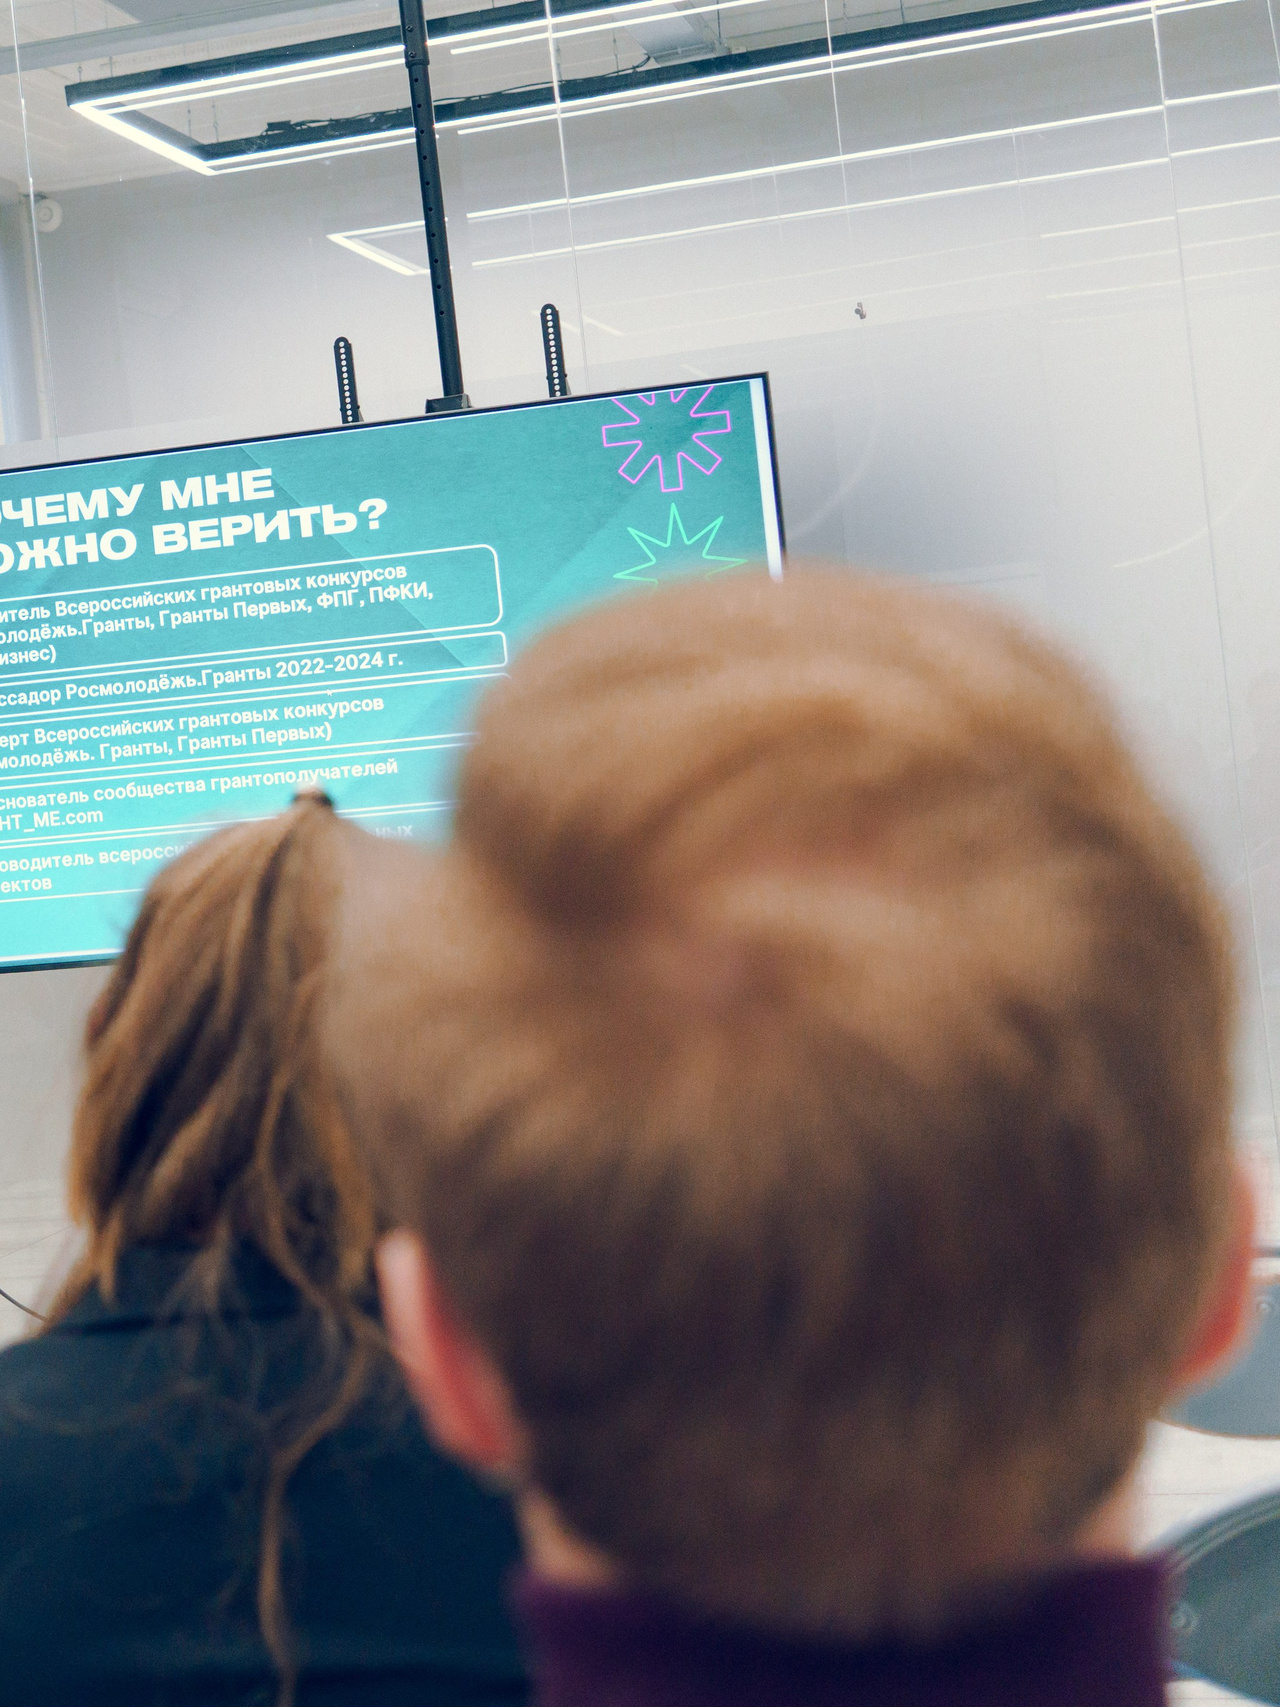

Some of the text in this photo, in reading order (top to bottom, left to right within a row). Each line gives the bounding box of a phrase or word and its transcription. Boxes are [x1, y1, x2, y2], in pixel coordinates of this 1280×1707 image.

[160, 468, 275, 511] МНЕ
[152, 498, 388, 555] ВЕРИТЬ?
[55, 589, 196, 617] Всероссийских
[201, 577, 301, 603] грантовых
[306, 565, 407, 588] конкурсов
[159, 606, 229, 629] Гранты
[233, 599, 312, 619] Первых,
[316, 589, 365, 608] ФПГ,
[369, 581, 433, 604] ПФКИ,
[65, 666, 271, 700] Росмолодёжь.Гранты
[276, 651, 384, 678] 2022-2024
[388, 653, 404, 667] г.
[34, 716, 174, 745] Всероссийских
[179, 707, 279, 732] грантовых
[284, 697, 384, 720] конкурсов
[100, 740, 173, 762] Гранты,
[177, 732, 247, 754] Гранты
[251, 721, 333, 746] Первых)
[93, 779, 206, 801] сообщества
[211, 758, 398, 793] грантополучателей
